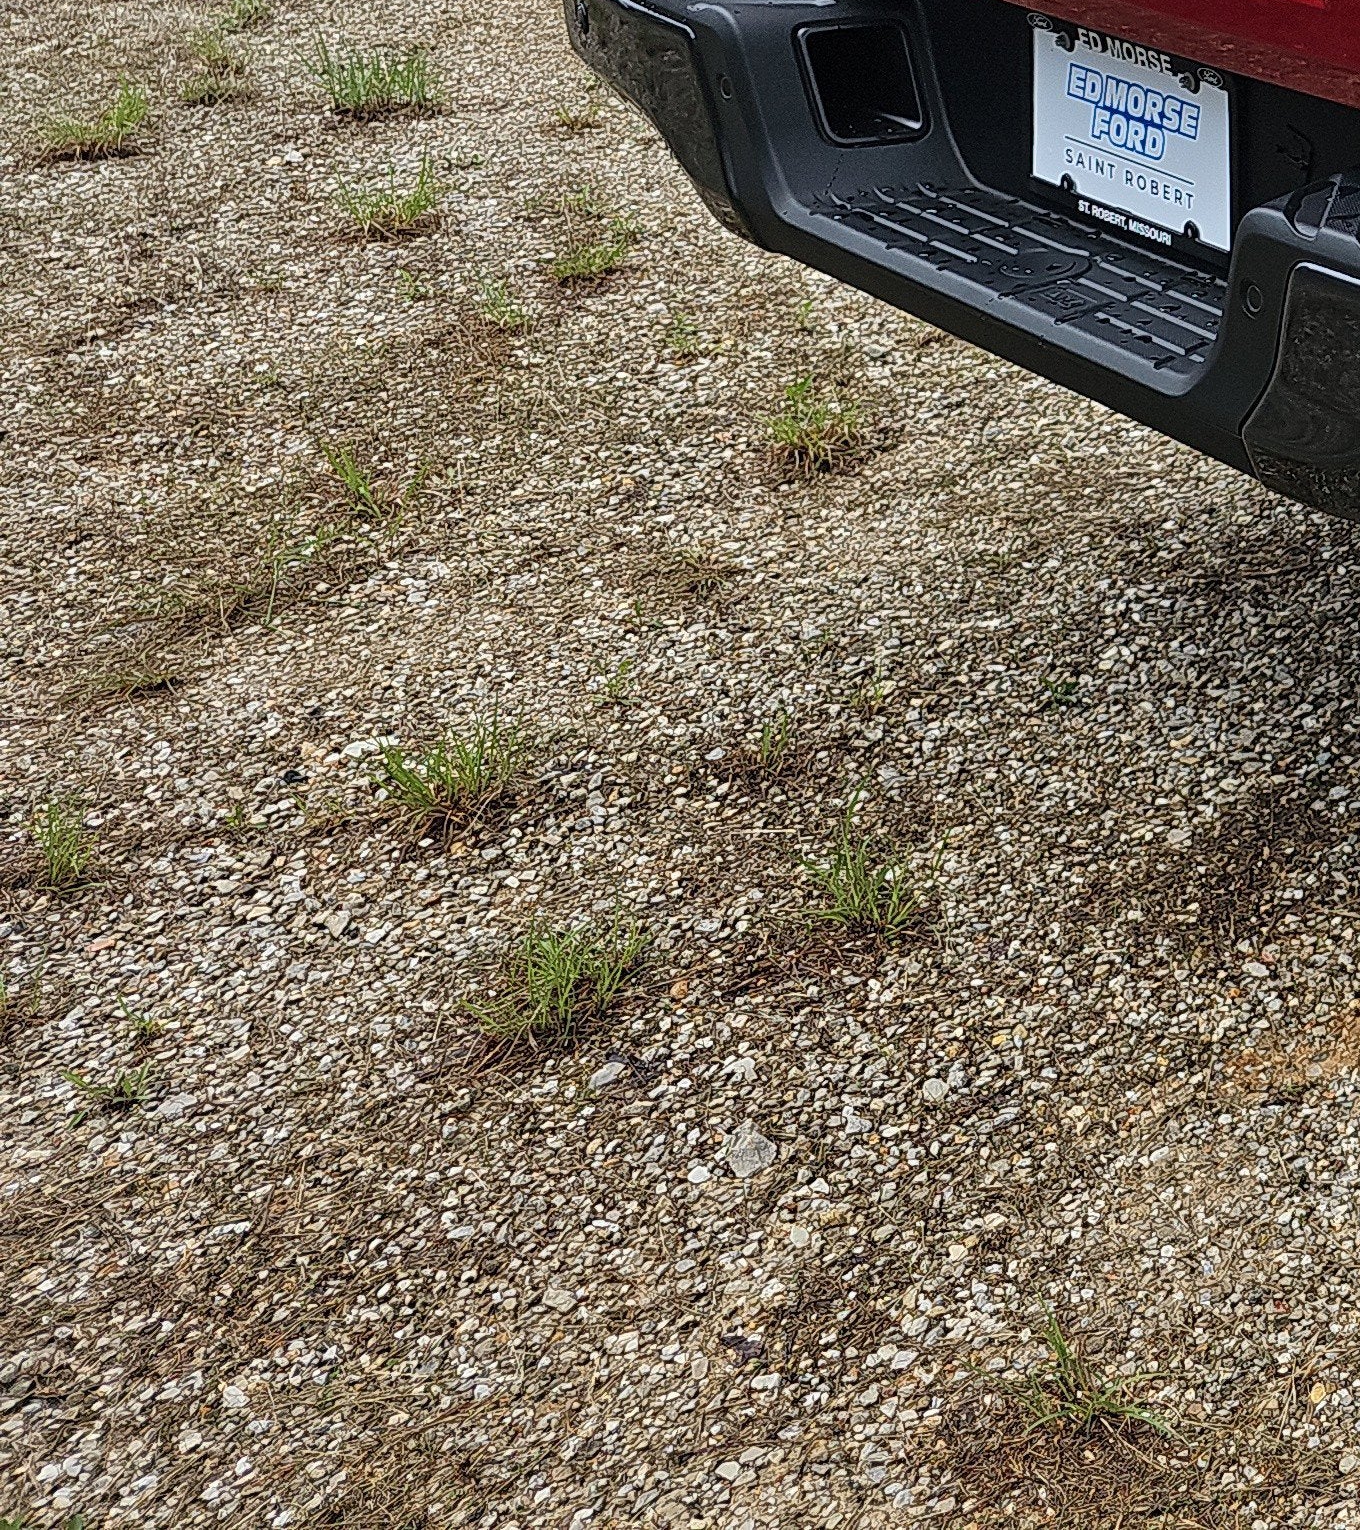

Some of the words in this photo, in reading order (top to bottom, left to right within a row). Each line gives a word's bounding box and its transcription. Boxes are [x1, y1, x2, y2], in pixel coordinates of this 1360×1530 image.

[1077, 27, 1103, 52] ED
[1105, 36, 1174, 76] MORSE
[1067, 63, 1103, 104] ED
[1103, 75, 1200, 140] MORSE
[1091, 106, 1165, 160] FORD
[1065, 148, 1116, 179] SAINT
[1125, 170, 1195, 210] ROBERT
[1128, 220, 1173, 246] MISSOURI
